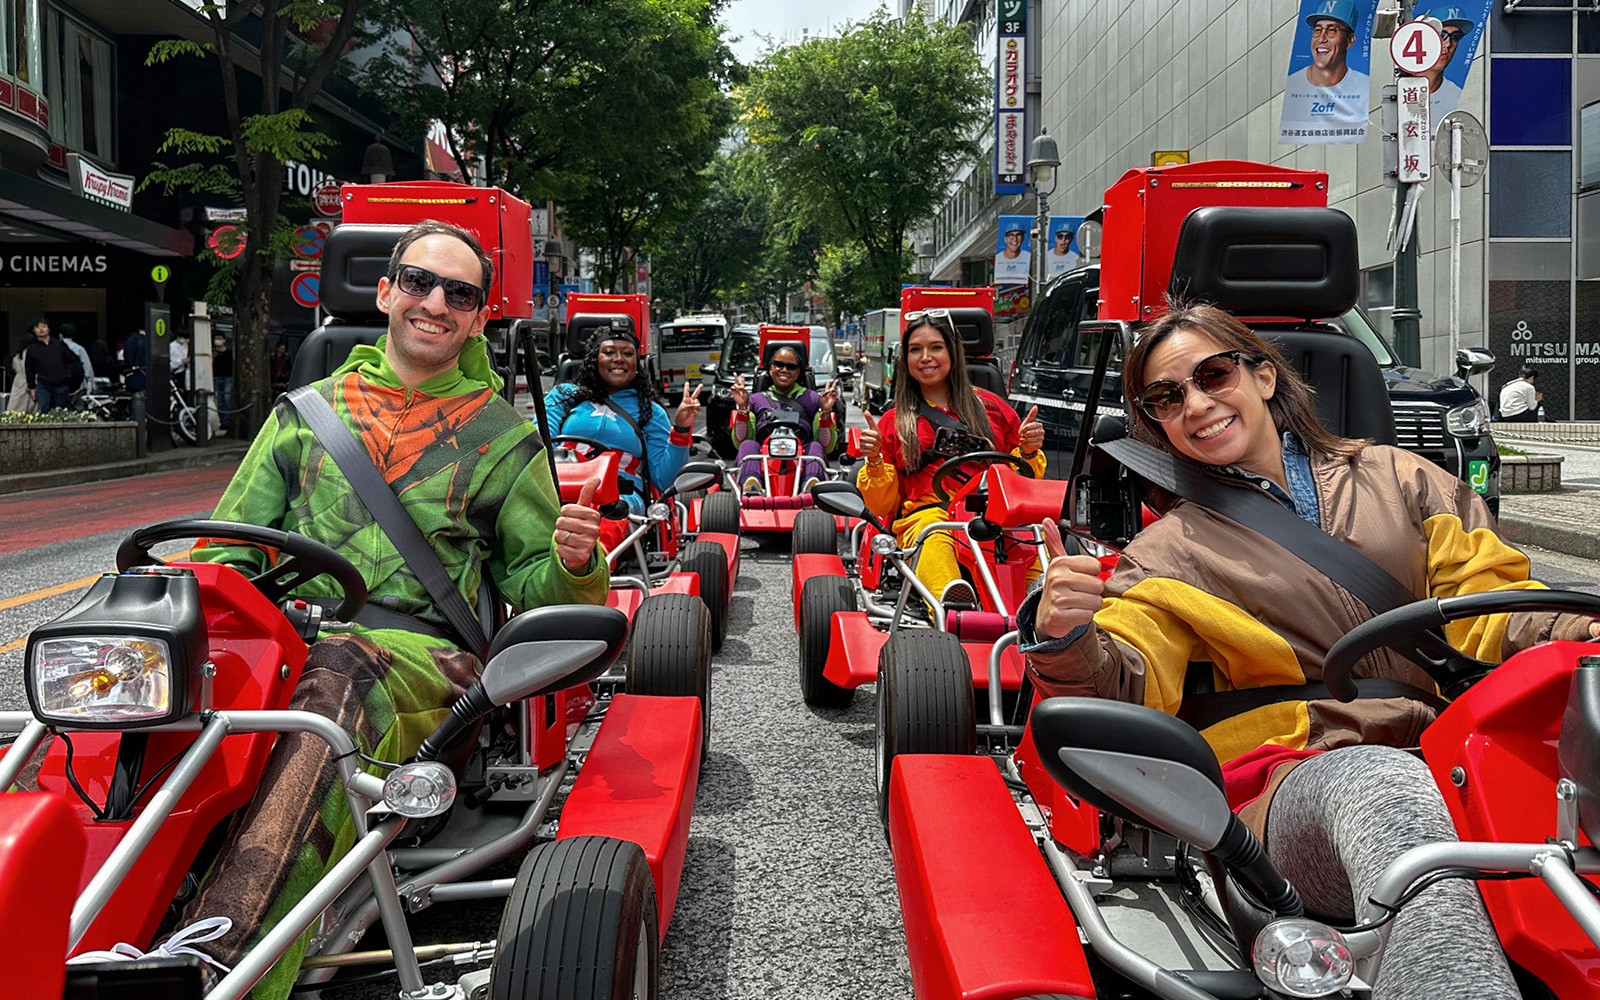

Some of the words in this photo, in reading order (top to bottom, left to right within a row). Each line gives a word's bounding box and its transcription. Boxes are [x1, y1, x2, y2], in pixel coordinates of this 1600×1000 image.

[1004, 1, 1021, 18] ツ
[1005, 22, 1020, 33] 3F
[1402, 30, 1427, 64] 4
[1005, 49, 1018, 96] カラオケ
[1310, 102, 1335, 113] Zoff
[1402, 87, 1420, 172] 道玄坂
[1005, 114, 1018, 172] まねきねこ
[1004, 174, 1018, 183] 4F
[9, 255, 108, 272] CINEMAS
[1525, 356, 1568, 364] mitsumaru
